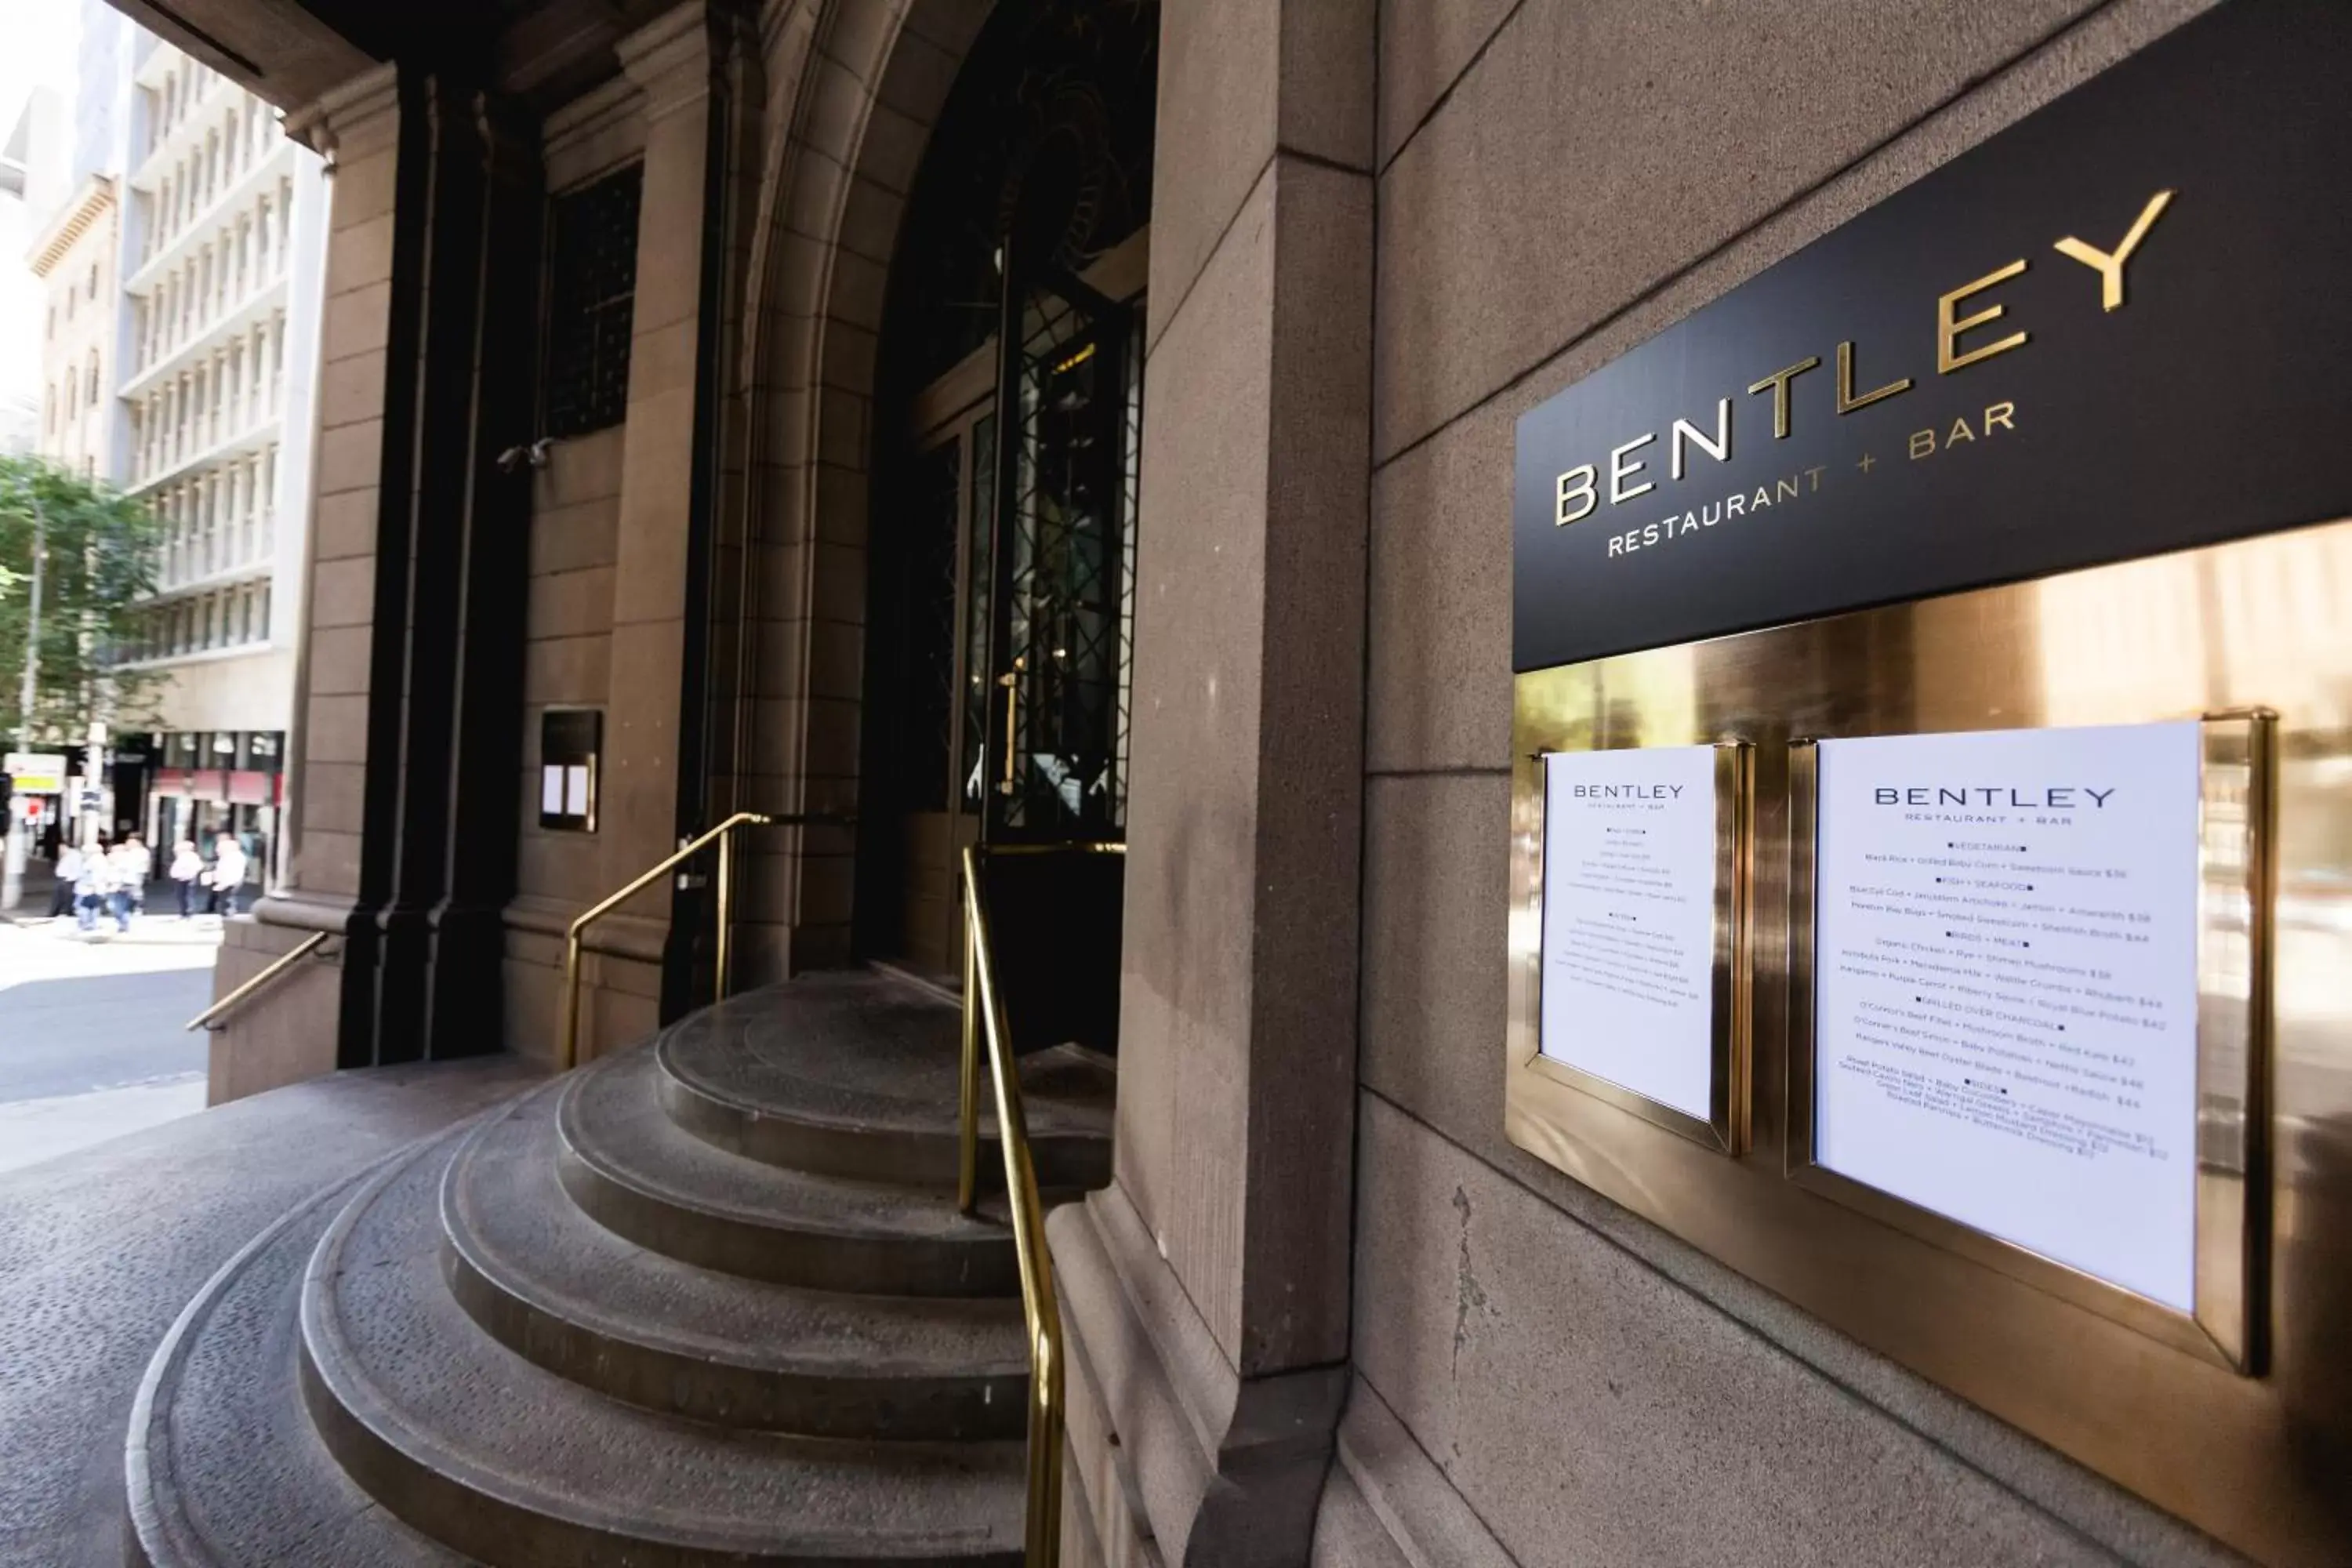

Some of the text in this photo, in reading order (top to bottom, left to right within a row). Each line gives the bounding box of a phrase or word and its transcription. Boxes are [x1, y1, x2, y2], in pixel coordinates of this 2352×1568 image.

[1555, 188, 2177, 528] BENTLEY
[1607, 401, 2016, 559] RESTAURANT + BAR
[1574, 785, 1684, 799] BENTLEY
[1875, 787, 2117, 808] BENTLEY
[1905, 812, 2007, 824] RESTAURANT
[2036, 816, 2072, 826] BAR
[1955, 841, 2019, 852] VEGETARIAN
[1973, 880, 2026, 892] SEAFOOD
[1922, 996, 2056, 1031] GRILLED OVER CHARCOAL
[1970, 1079, 2001, 1094] SIDES
